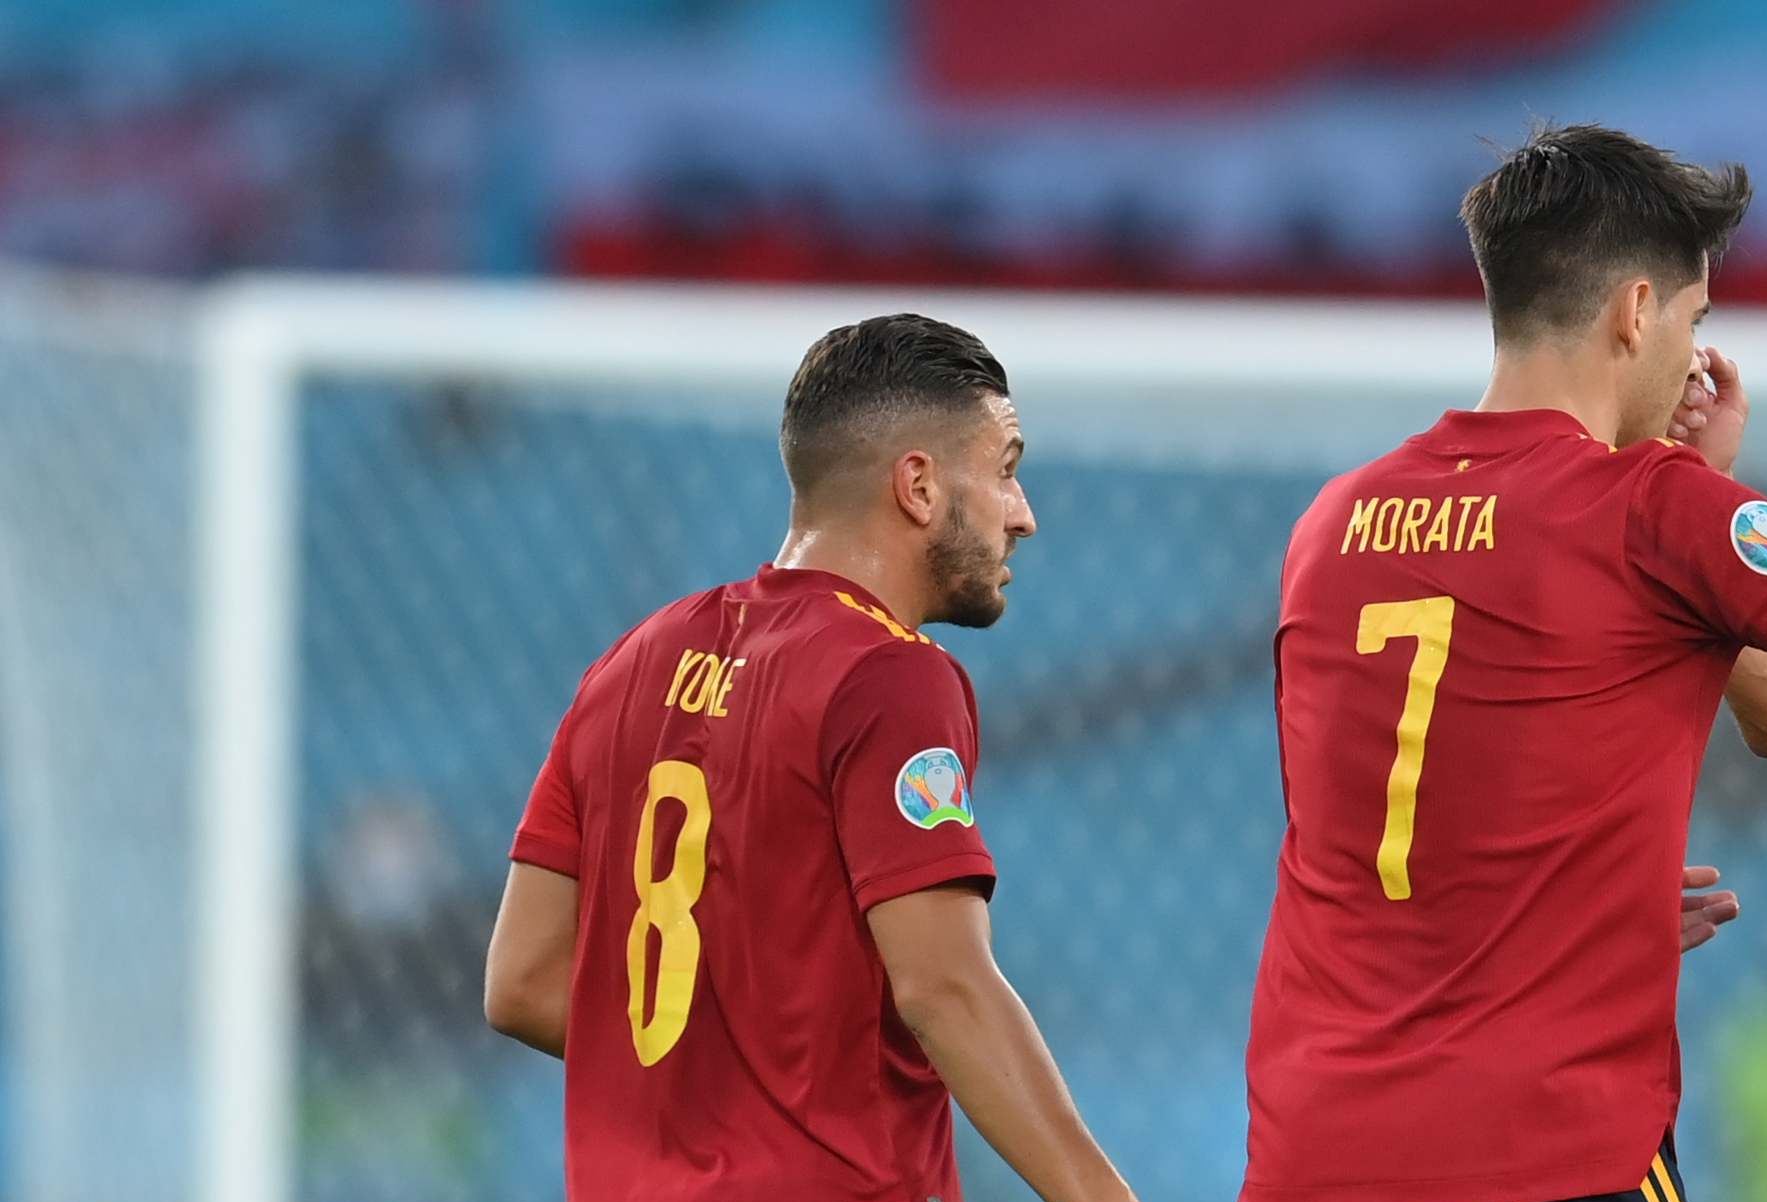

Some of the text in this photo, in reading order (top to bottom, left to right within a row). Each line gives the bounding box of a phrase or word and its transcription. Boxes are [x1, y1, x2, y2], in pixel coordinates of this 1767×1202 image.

[1340, 495, 1497, 555] MORATA
[1355, 595, 1456, 900] 7
[626, 760, 712, 1067] 8
